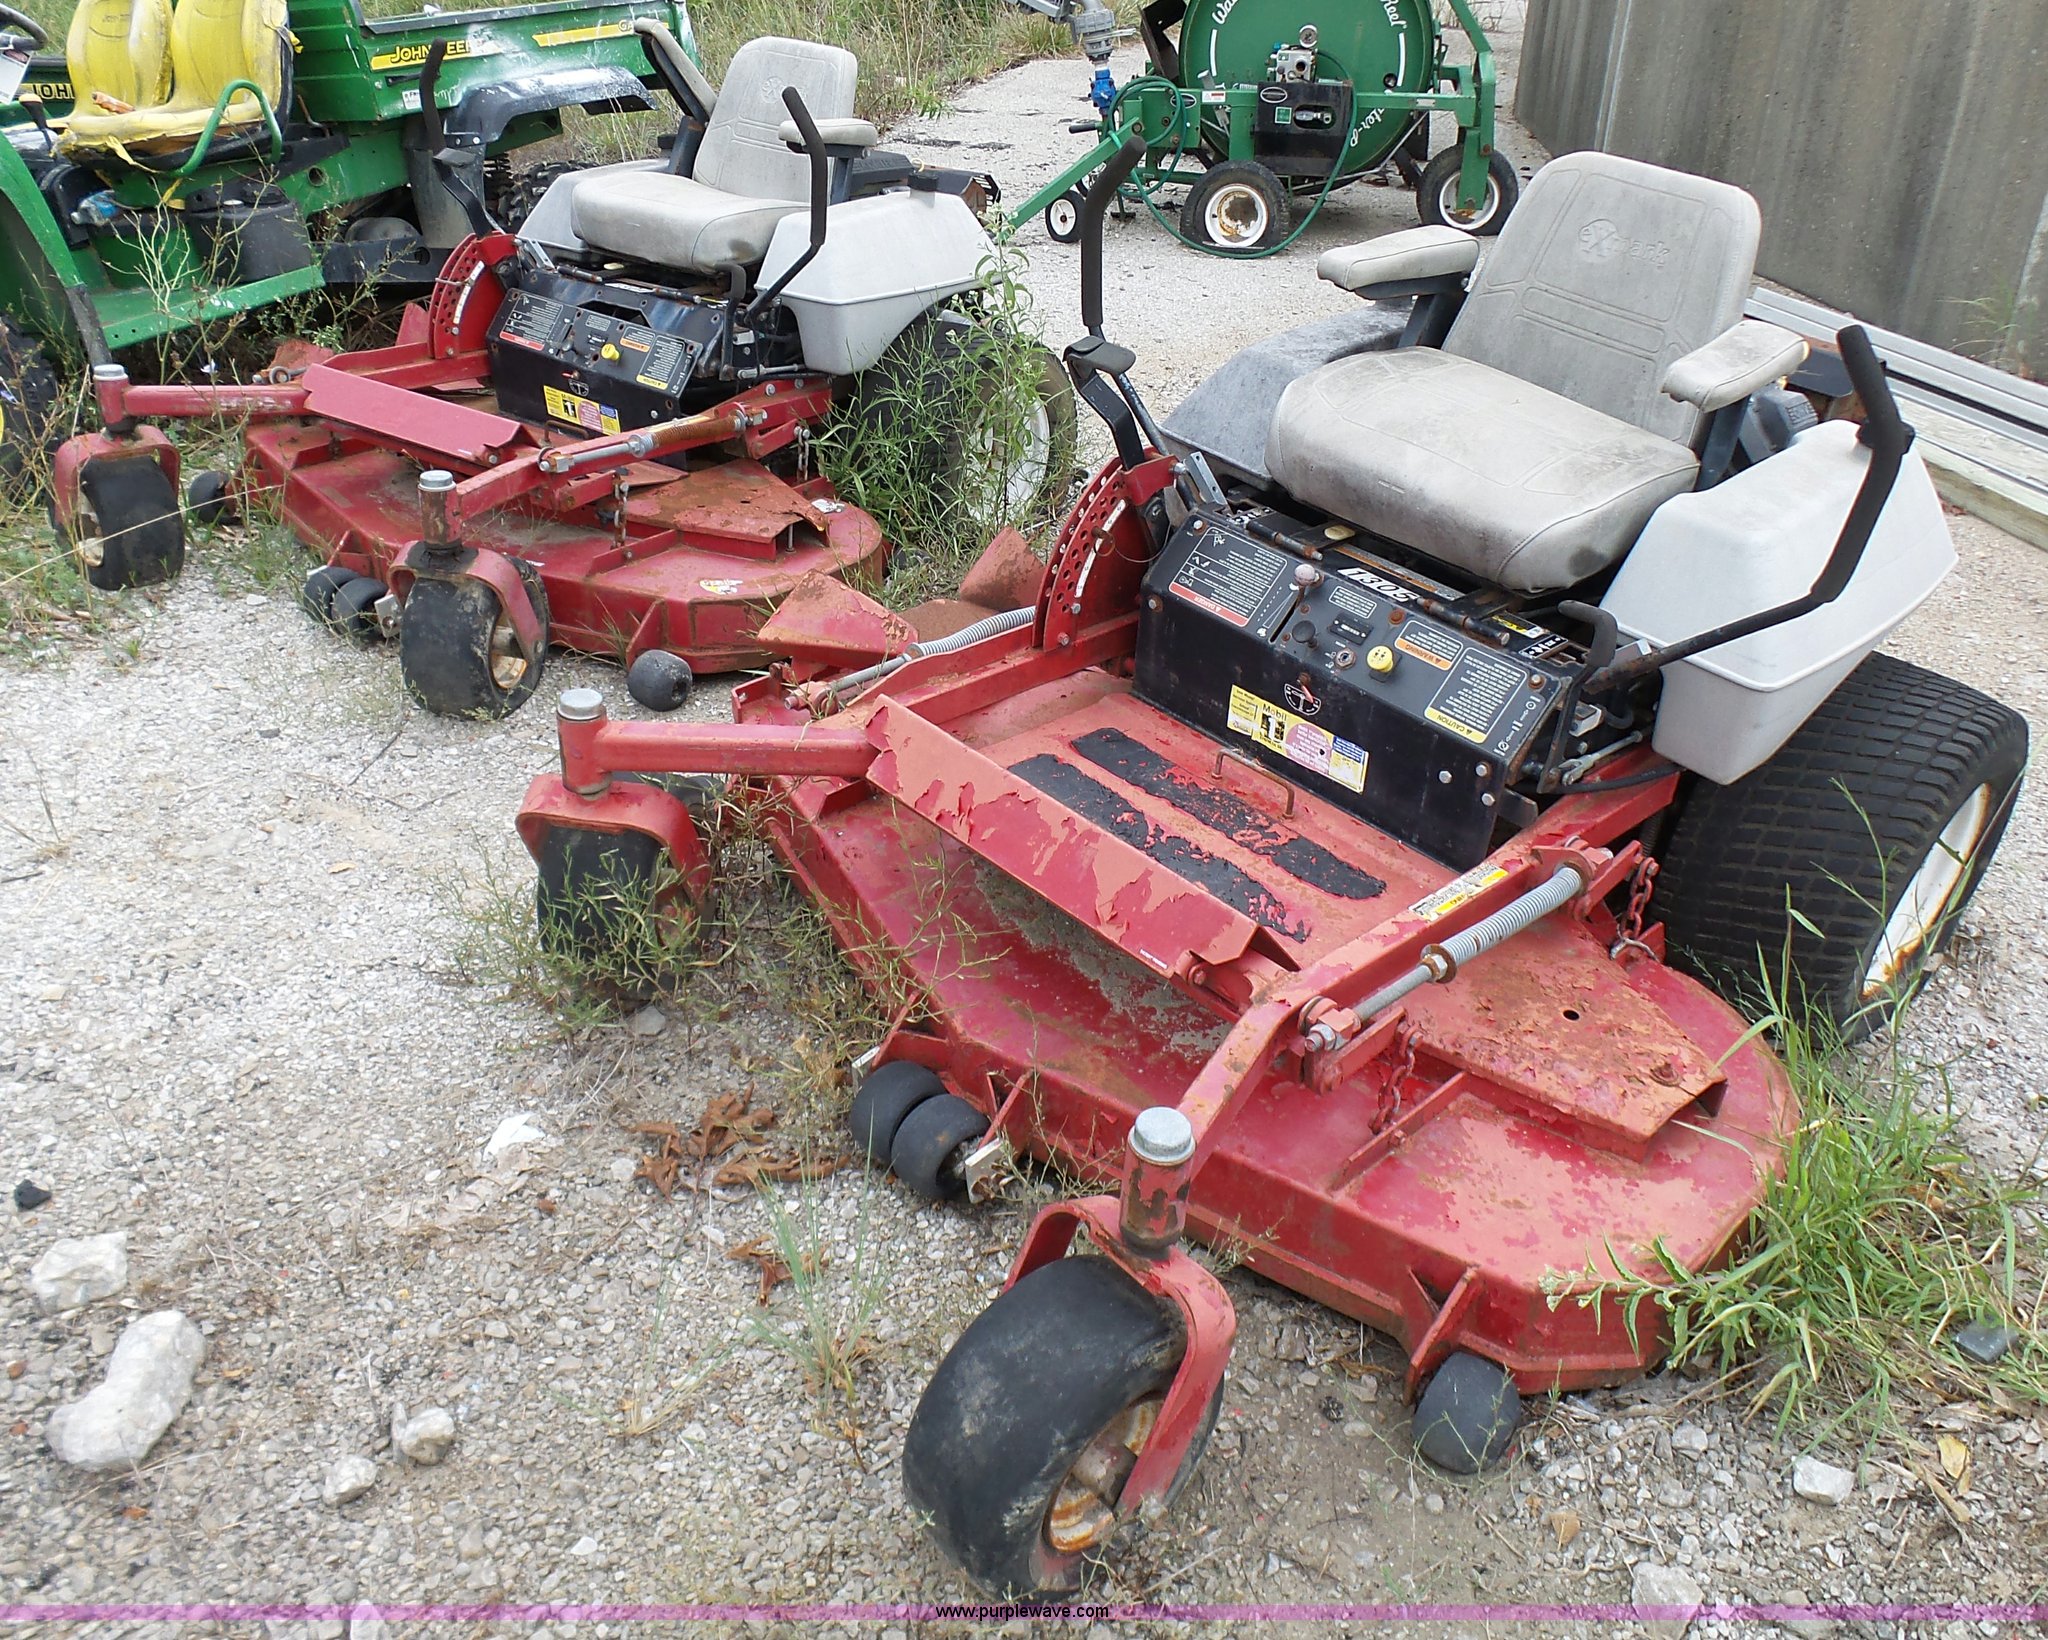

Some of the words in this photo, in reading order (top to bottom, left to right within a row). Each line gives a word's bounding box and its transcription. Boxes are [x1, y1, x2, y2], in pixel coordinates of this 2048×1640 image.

[1351, 569, 1418, 601] 1305
[1262, 703, 1287, 722] Mobil
[1436, 713, 1466, 733] CAUTION
